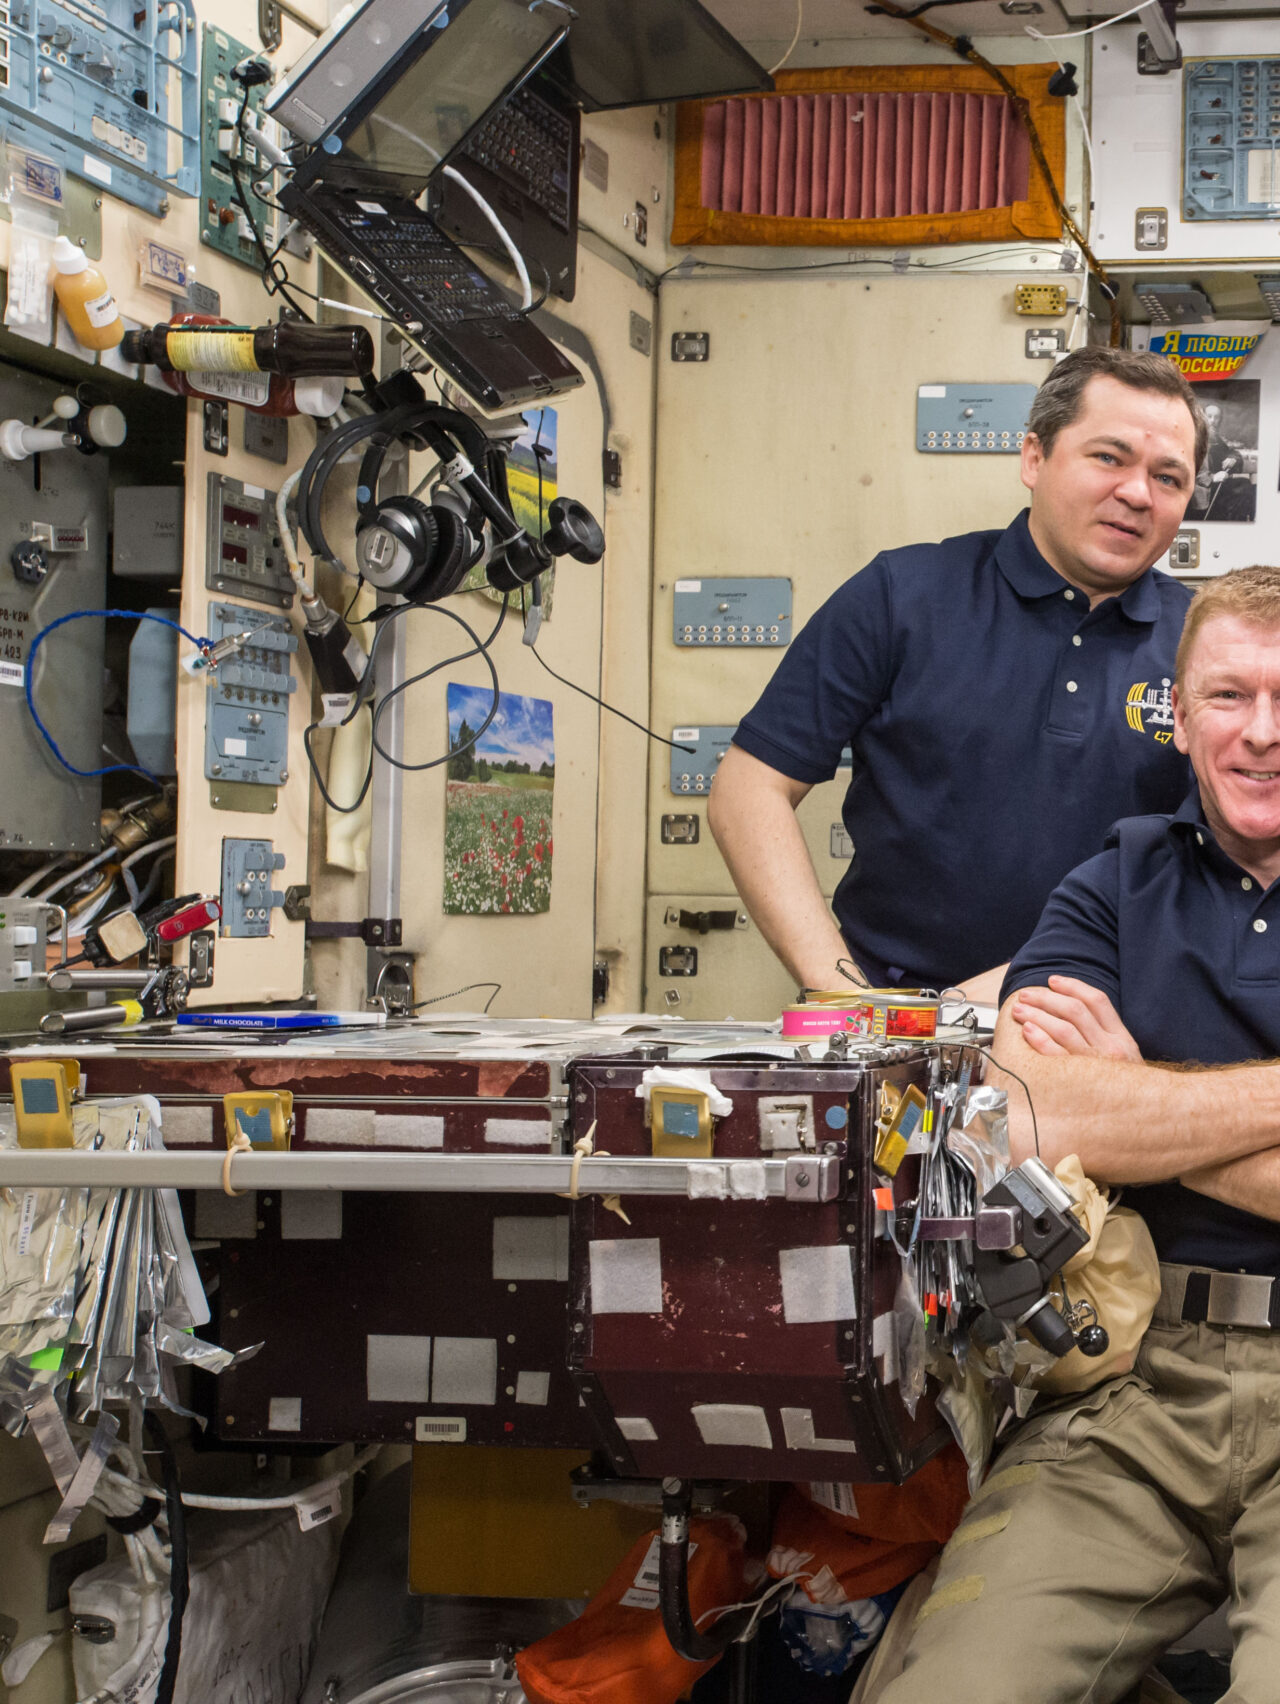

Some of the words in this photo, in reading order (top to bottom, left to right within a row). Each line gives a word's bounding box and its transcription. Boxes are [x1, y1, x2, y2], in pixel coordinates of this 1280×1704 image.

[1160, 329, 1182, 353] Я
[1185, 334, 1259, 353] ЛЮБЛЮ
[1153, 730, 1173, 745] 47
[213, 1018, 228, 1026] MILK
[228, 1018, 264, 1027] CHOCOLATE
[873, 1008, 886, 1035] DIP
